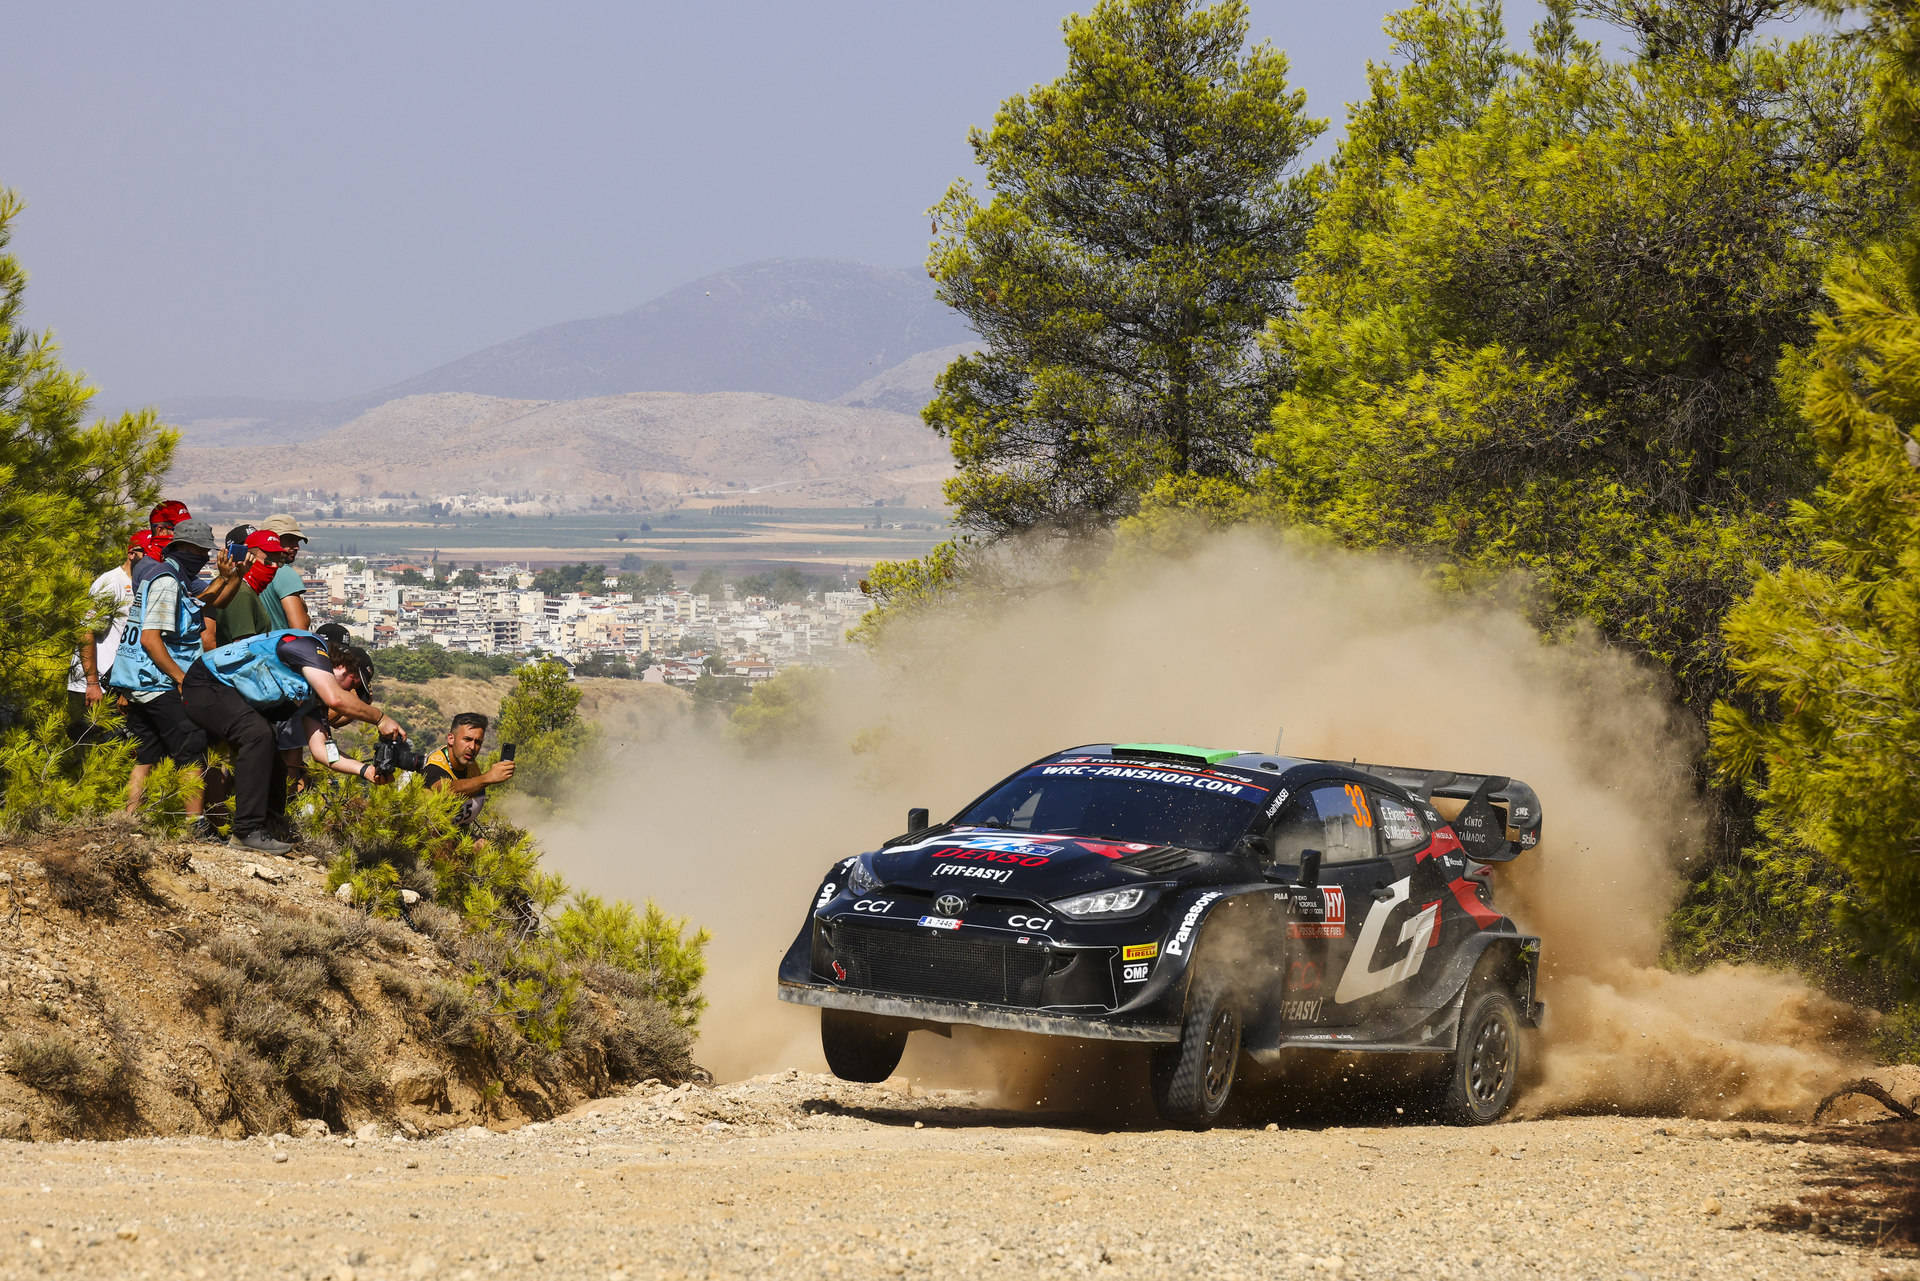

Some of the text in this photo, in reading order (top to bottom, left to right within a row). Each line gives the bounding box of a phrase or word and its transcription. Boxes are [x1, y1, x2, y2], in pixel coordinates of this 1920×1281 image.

[1091, 758, 1145, 767] TOYOTA
[1042, 766, 1243, 795] WRC-FANSHOP.COM
[1344, 783, 1373, 828] 33
[931, 848, 1050, 867] DENSO
[1325, 892, 1342, 918] HY
[1165, 892, 1223, 956] Panasonic
[1126, 945, 1156, 958] PIRELLI
[1124, 965, 1149, 980] OMP
